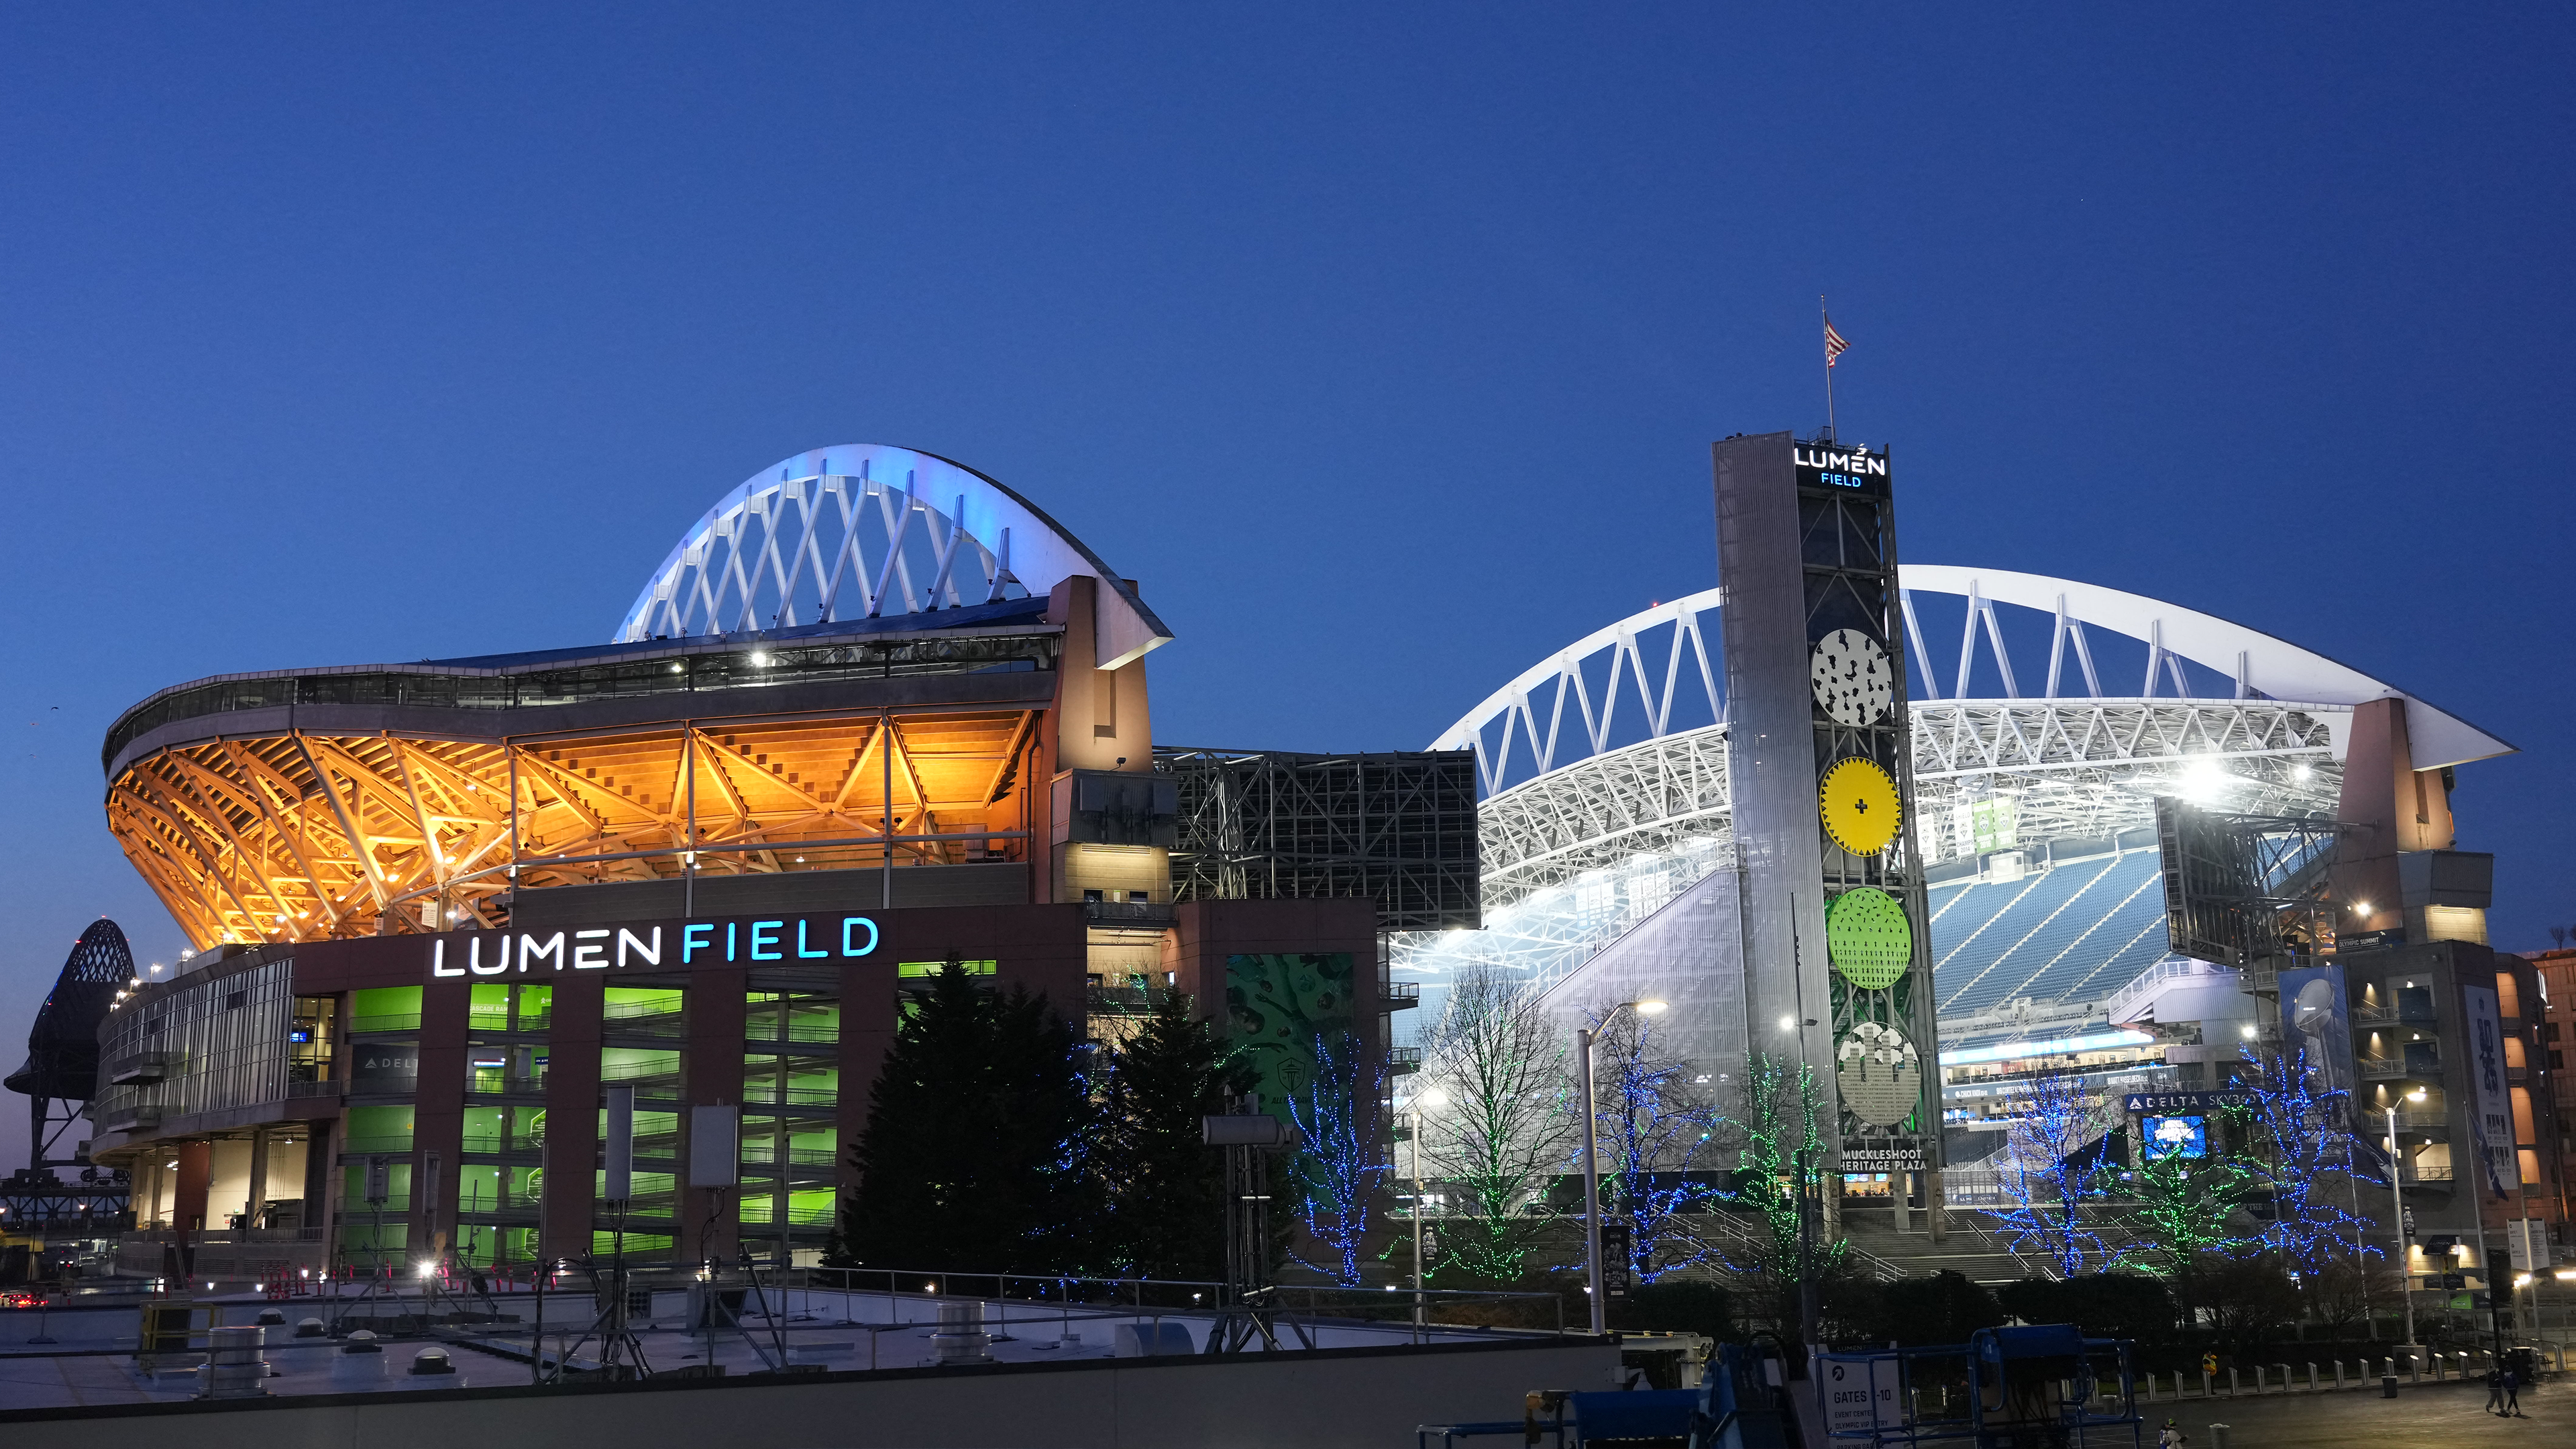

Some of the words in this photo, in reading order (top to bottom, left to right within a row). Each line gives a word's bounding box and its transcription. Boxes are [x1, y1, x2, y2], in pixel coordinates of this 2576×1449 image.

[1794, 447, 1885, 476] LUMEN
[1821, 473, 1861, 488] FIELD
[1957, 839, 1974, 847] CHAMPS
[1980, 840, 1991, 849] 2016
[2360, 937, 2379, 945] SUMMIT
[434, 926, 661, 977] LUMEN
[682, 917, 879, 963] FIELD
[382, 1058, 419, 1068] DELT
[1960, 1089, 1972, 1097] CHUCK
[2146, 1095, 2199, 1108] DELTA
[1842, 1149, 1922, 1160] MUCKLESHOOT
[1841, 1161, 1890, 1171] HERITAGE
[1894, 1161, 1927, 1171] PLAZA
[1610, 1274, 1621, 1283] 50
[1834, 1391, 1867, 1403] GATES
